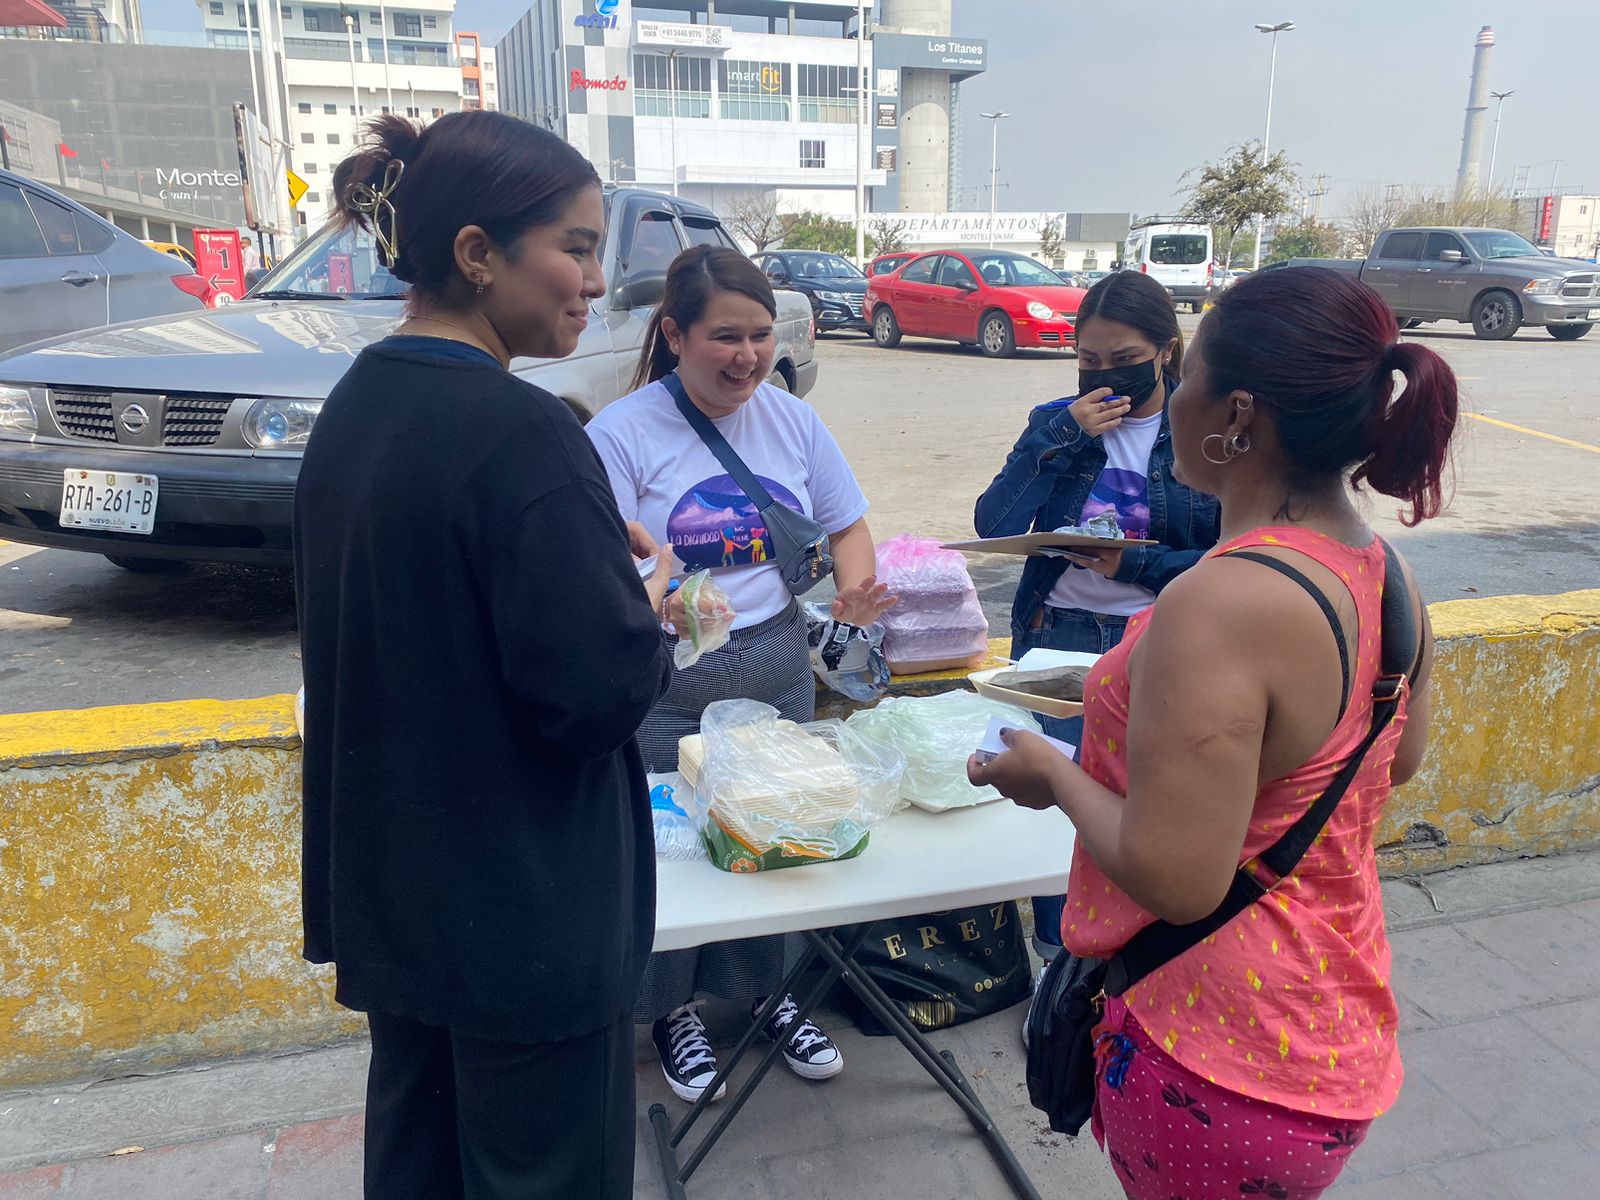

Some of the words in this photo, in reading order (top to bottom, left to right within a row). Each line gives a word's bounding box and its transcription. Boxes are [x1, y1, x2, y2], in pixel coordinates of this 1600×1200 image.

[928, 41, 946, 53] Los
[948, 42, 983, 55] Titanes
[569, 68, 627, 92] Promoda
[217, 247, 230, 269] 1
[64, 484, 153, 515] RTA-261-B
[734, 525, 745, 533] NO
[882, 903, 1008, 960] EREZ
